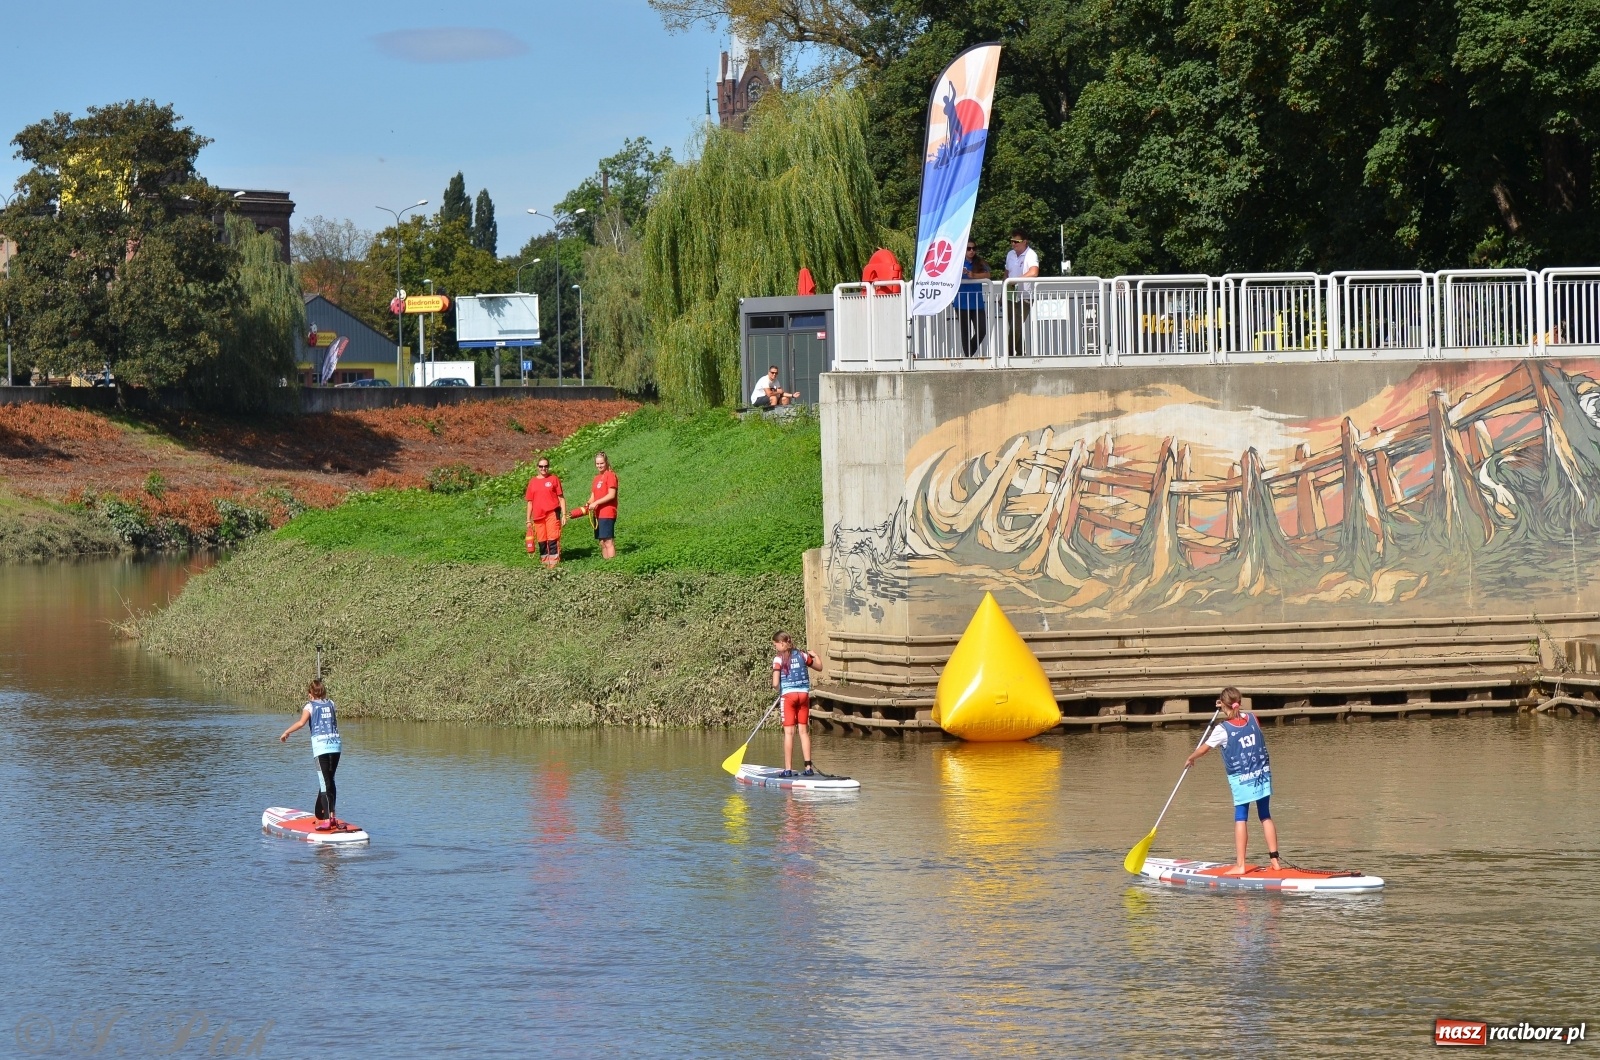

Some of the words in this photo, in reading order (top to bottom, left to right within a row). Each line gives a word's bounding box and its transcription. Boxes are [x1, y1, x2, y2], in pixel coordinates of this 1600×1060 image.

[930, 281, 955, 289] Sportowy
[918, 288, 942, 300] SUP
[407, 298, 440, 306] Biedronka
[1085, 308, 1097, 319] WC
[1238, 733, 1256, 749] 137
